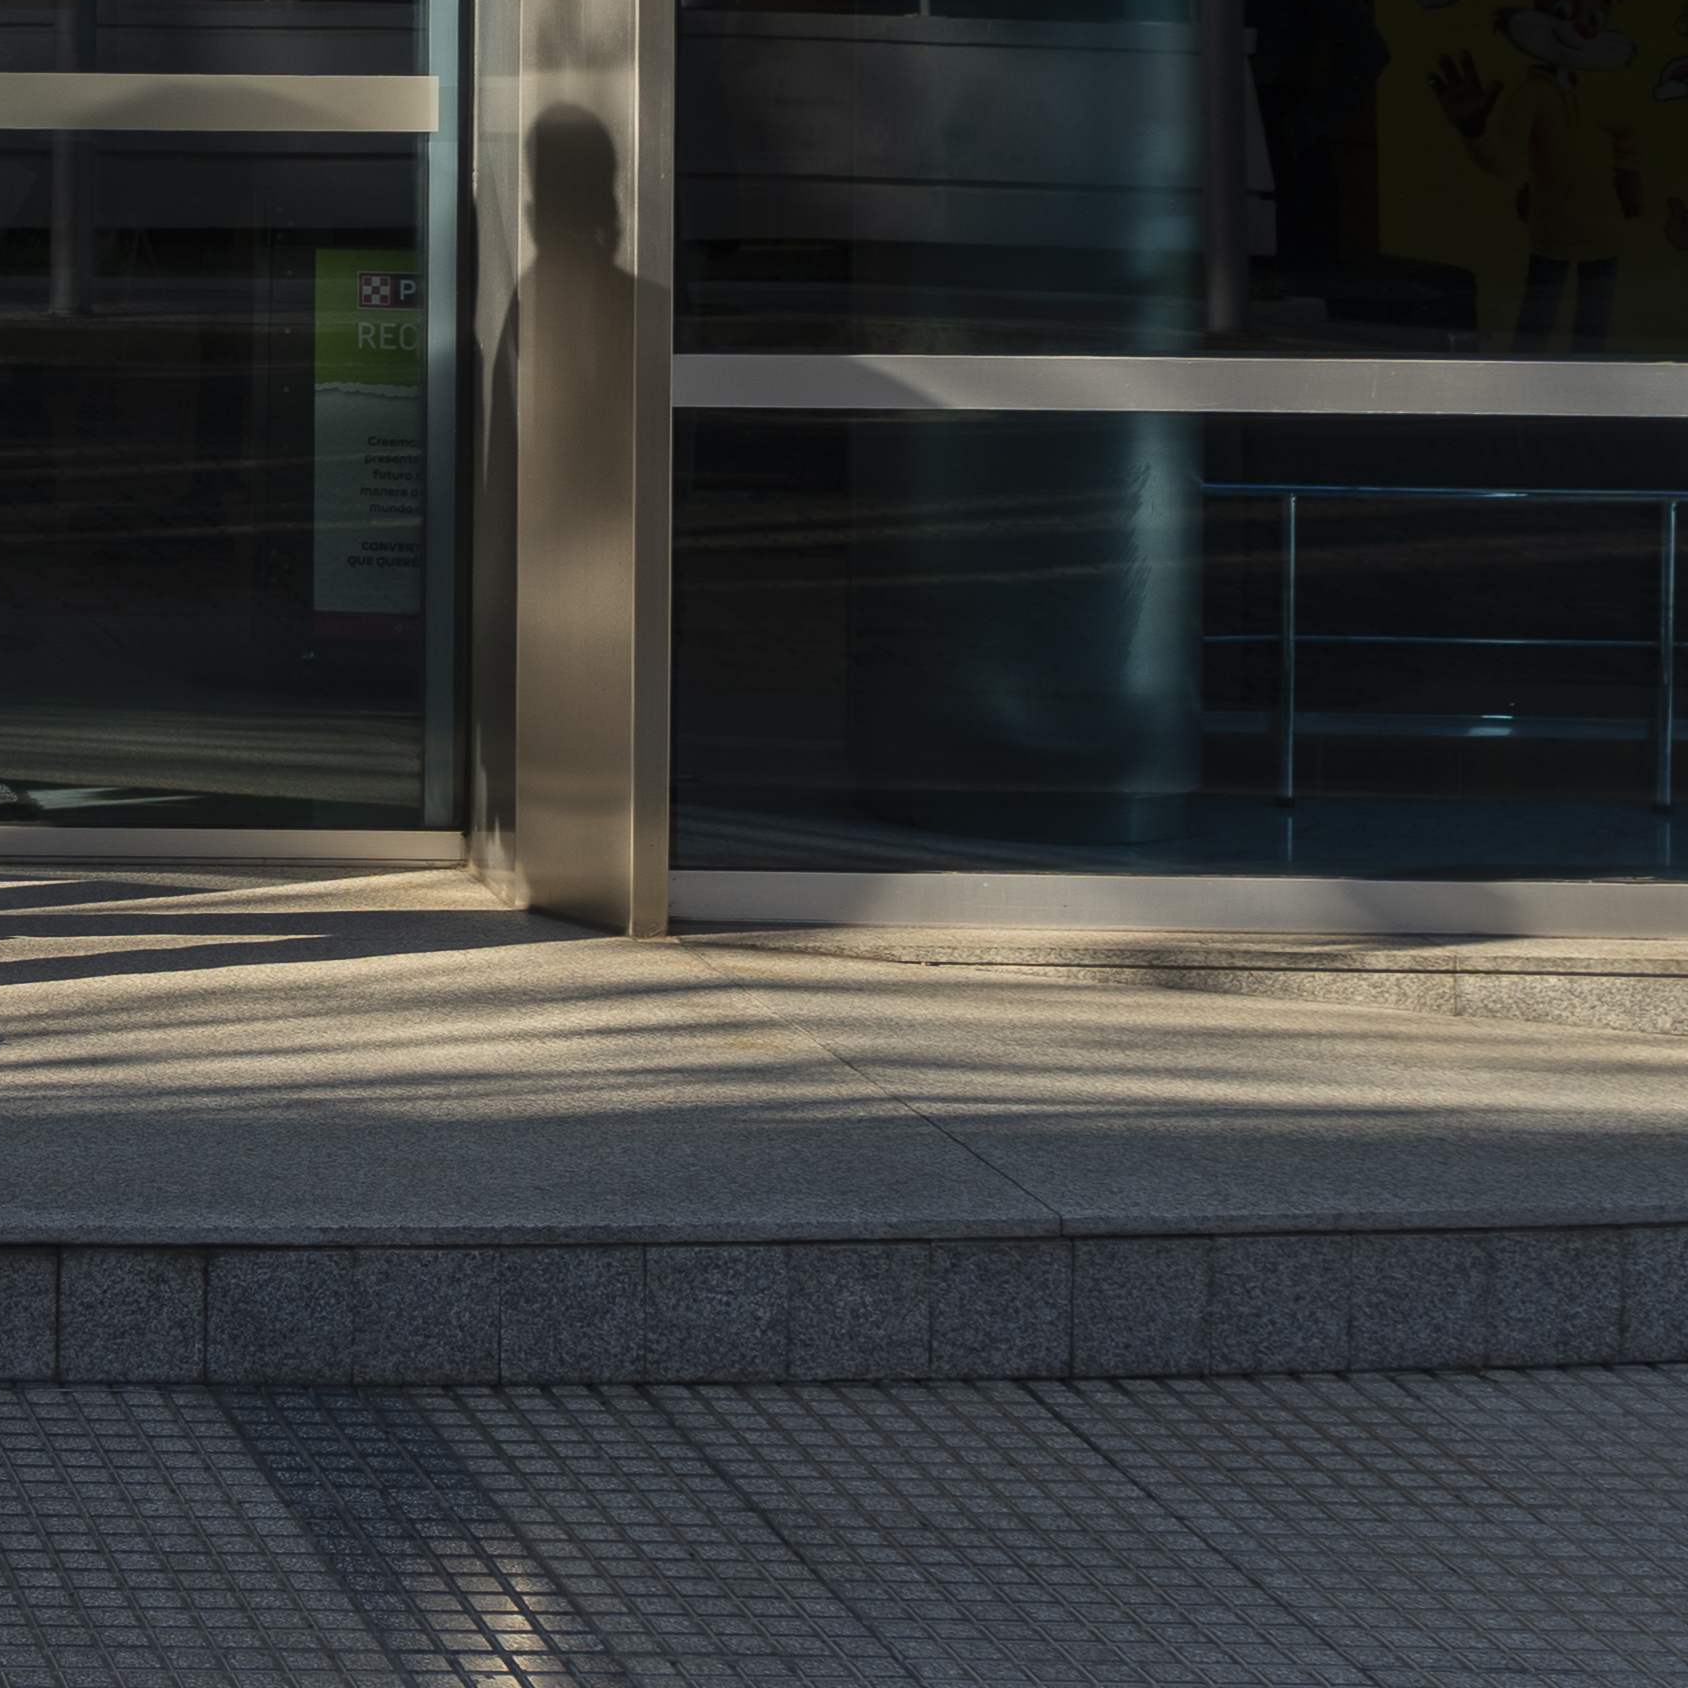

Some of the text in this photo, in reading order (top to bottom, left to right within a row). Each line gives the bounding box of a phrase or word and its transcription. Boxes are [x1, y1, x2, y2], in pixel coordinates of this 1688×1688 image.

[373, 468, 413, 481] futuro
[360, 487, 408, 497] manera
[369, 503, 414, 514] mundo
[347, 555, 422, 568] QUE QUERÉ
